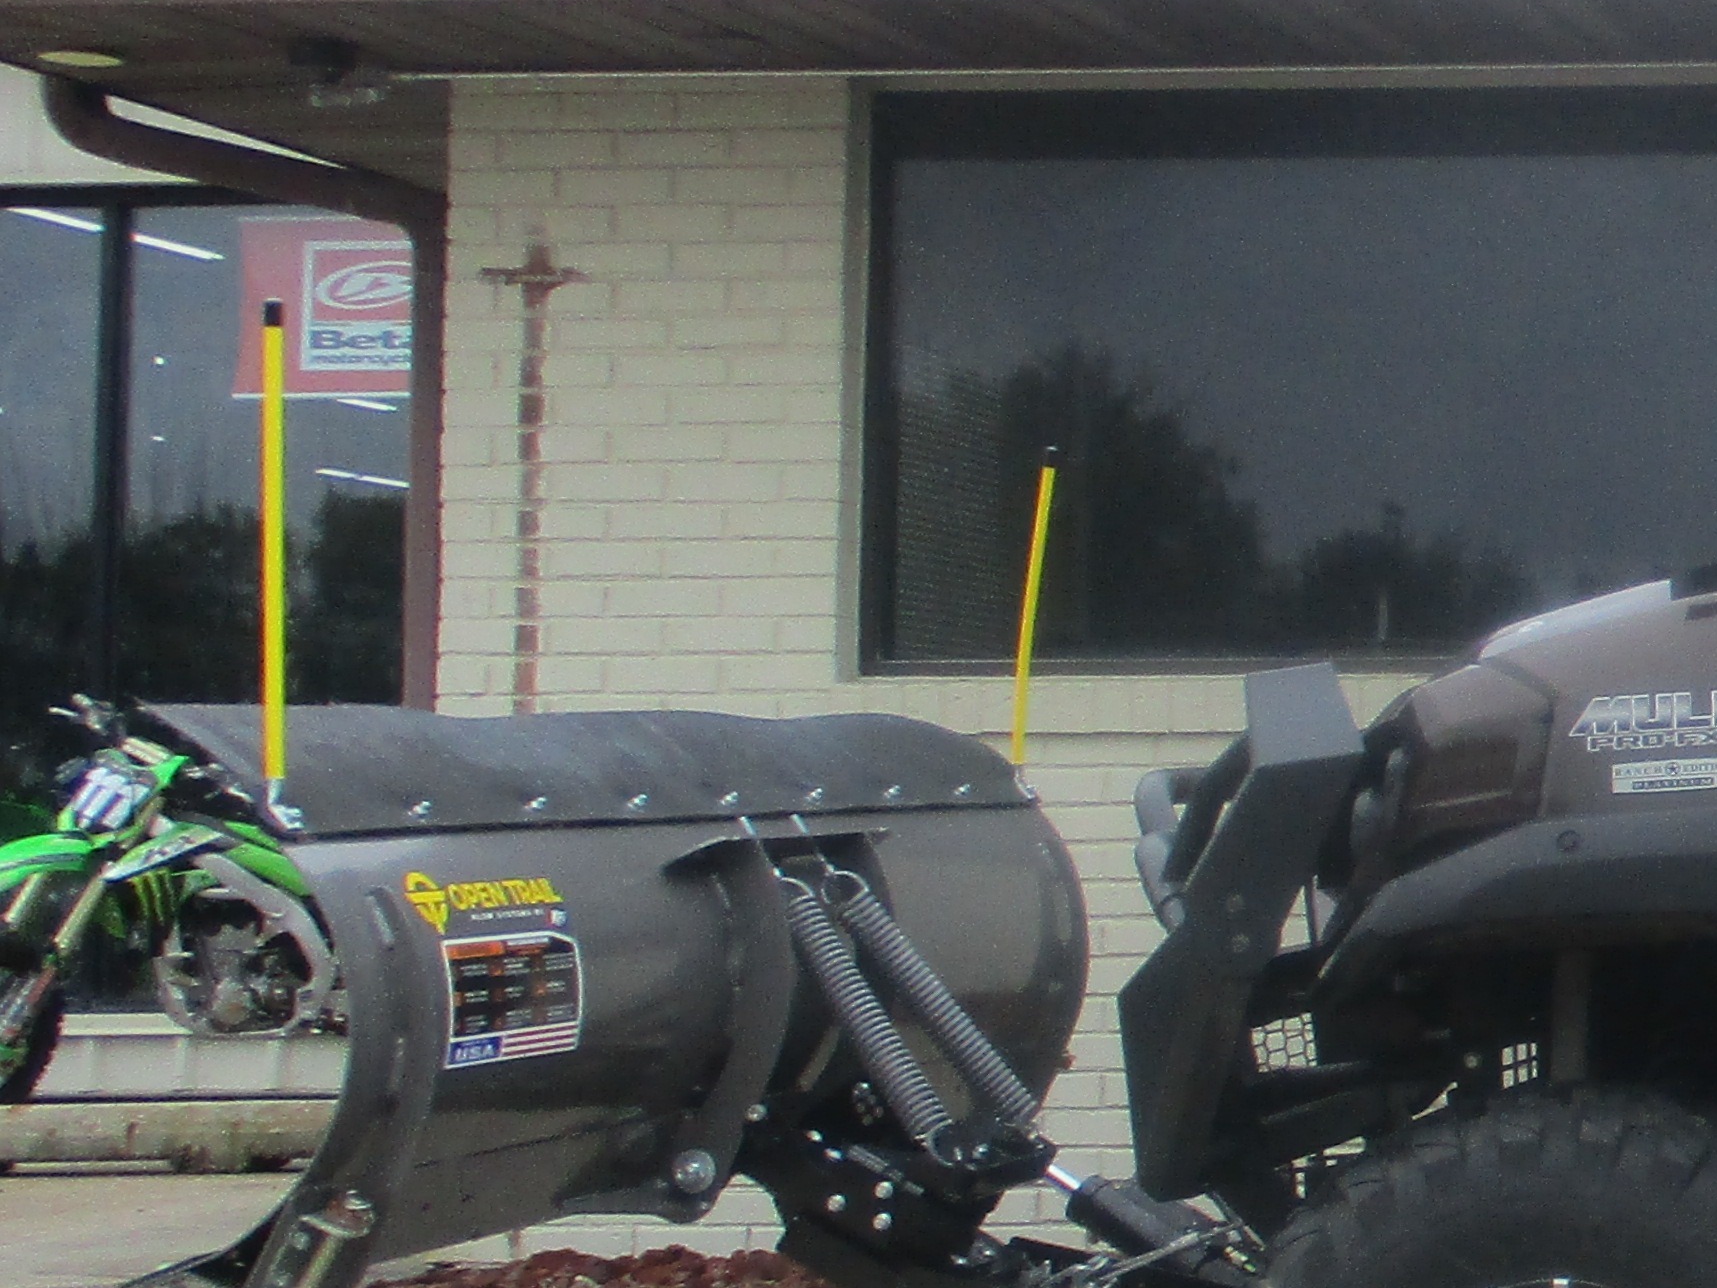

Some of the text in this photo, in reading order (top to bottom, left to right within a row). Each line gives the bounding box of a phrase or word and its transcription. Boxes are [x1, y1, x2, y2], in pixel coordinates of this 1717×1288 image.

[1614, 765, 1663, 777] RANCH
[1633, 777, 1714, 790] PLATINUM
[455, 1044, 495, 1062] USA
